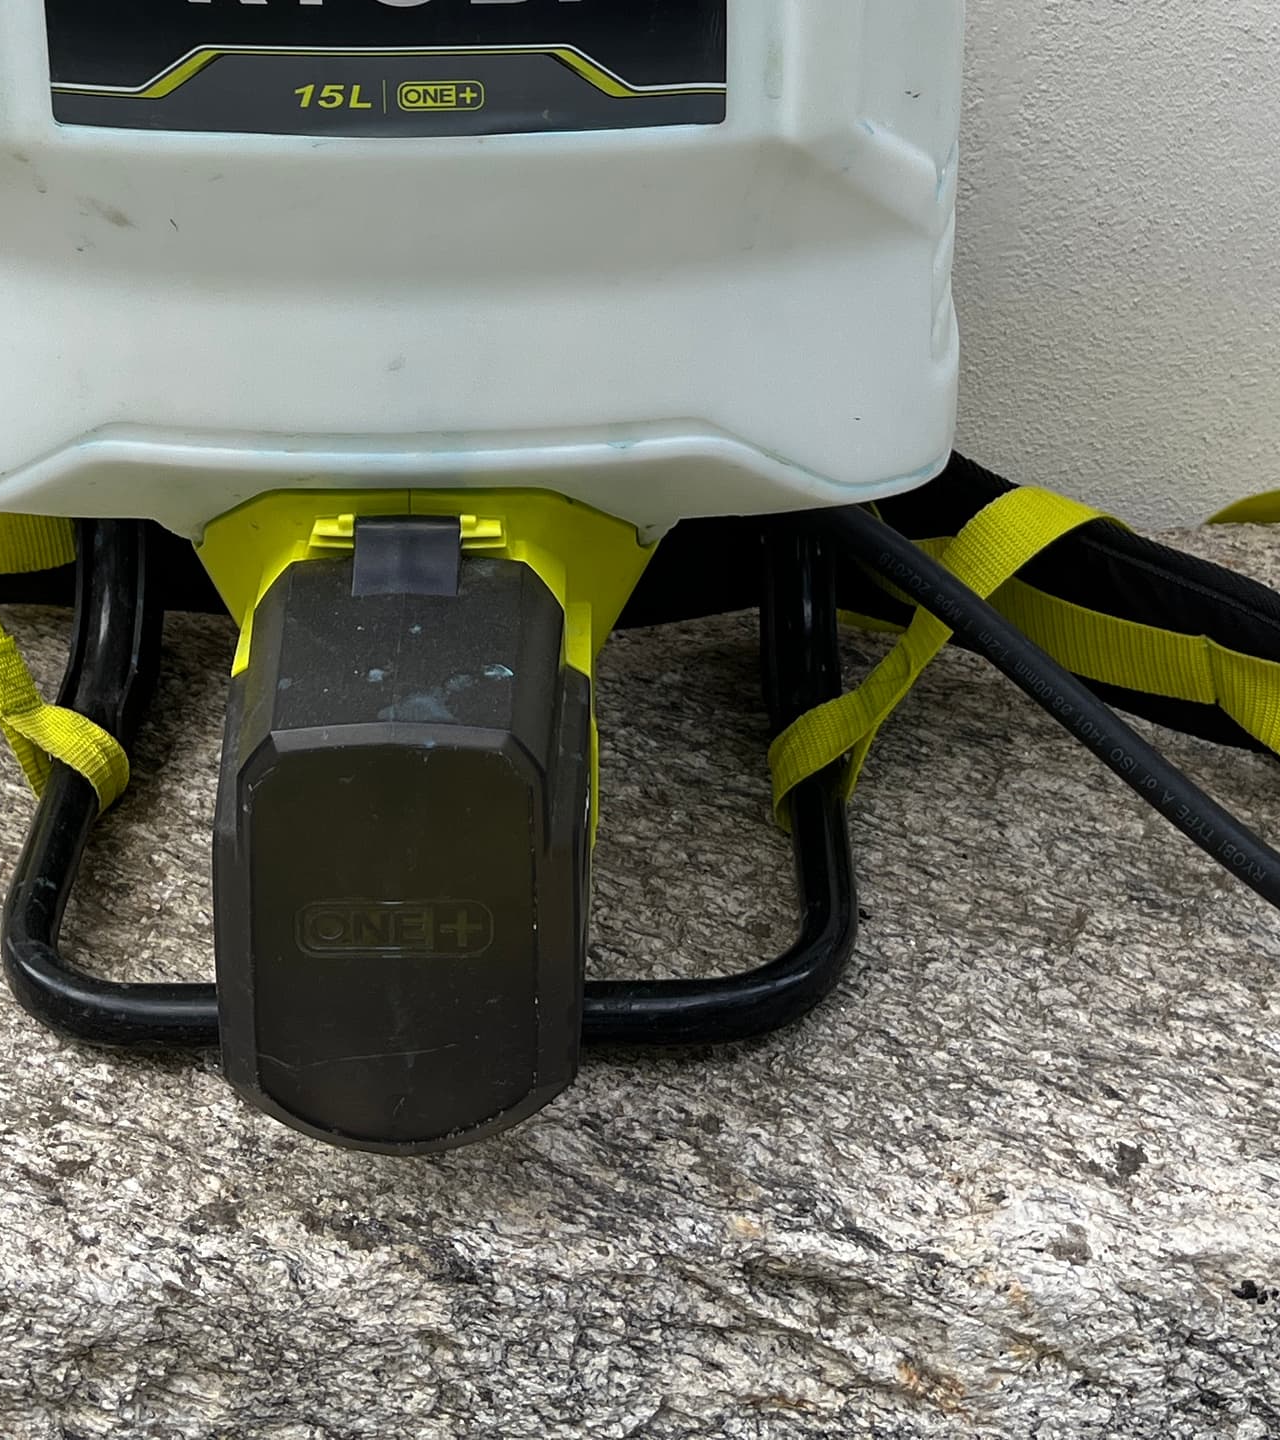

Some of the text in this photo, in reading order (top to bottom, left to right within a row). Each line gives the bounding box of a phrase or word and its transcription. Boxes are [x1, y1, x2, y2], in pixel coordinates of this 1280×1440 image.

[293, 84, 480, 110] 15L ONE+
[879, 551, 932, 594] 2Q2019
[935, 593, 964, 621] Mpa
[978, 630, 1009, 658] 1.2m
[1073, 714, 1105, 747] 1401
[1110, 747, 1139, 775] ISO
[1142, 774, 1159, 790] of
[1161, 789, 1176, 805] A
[1175, 804, 1215, 843] TYPE
[1216, 839, 1267, 882] RYOBI
[304, 903, 485, 951] ONE+
